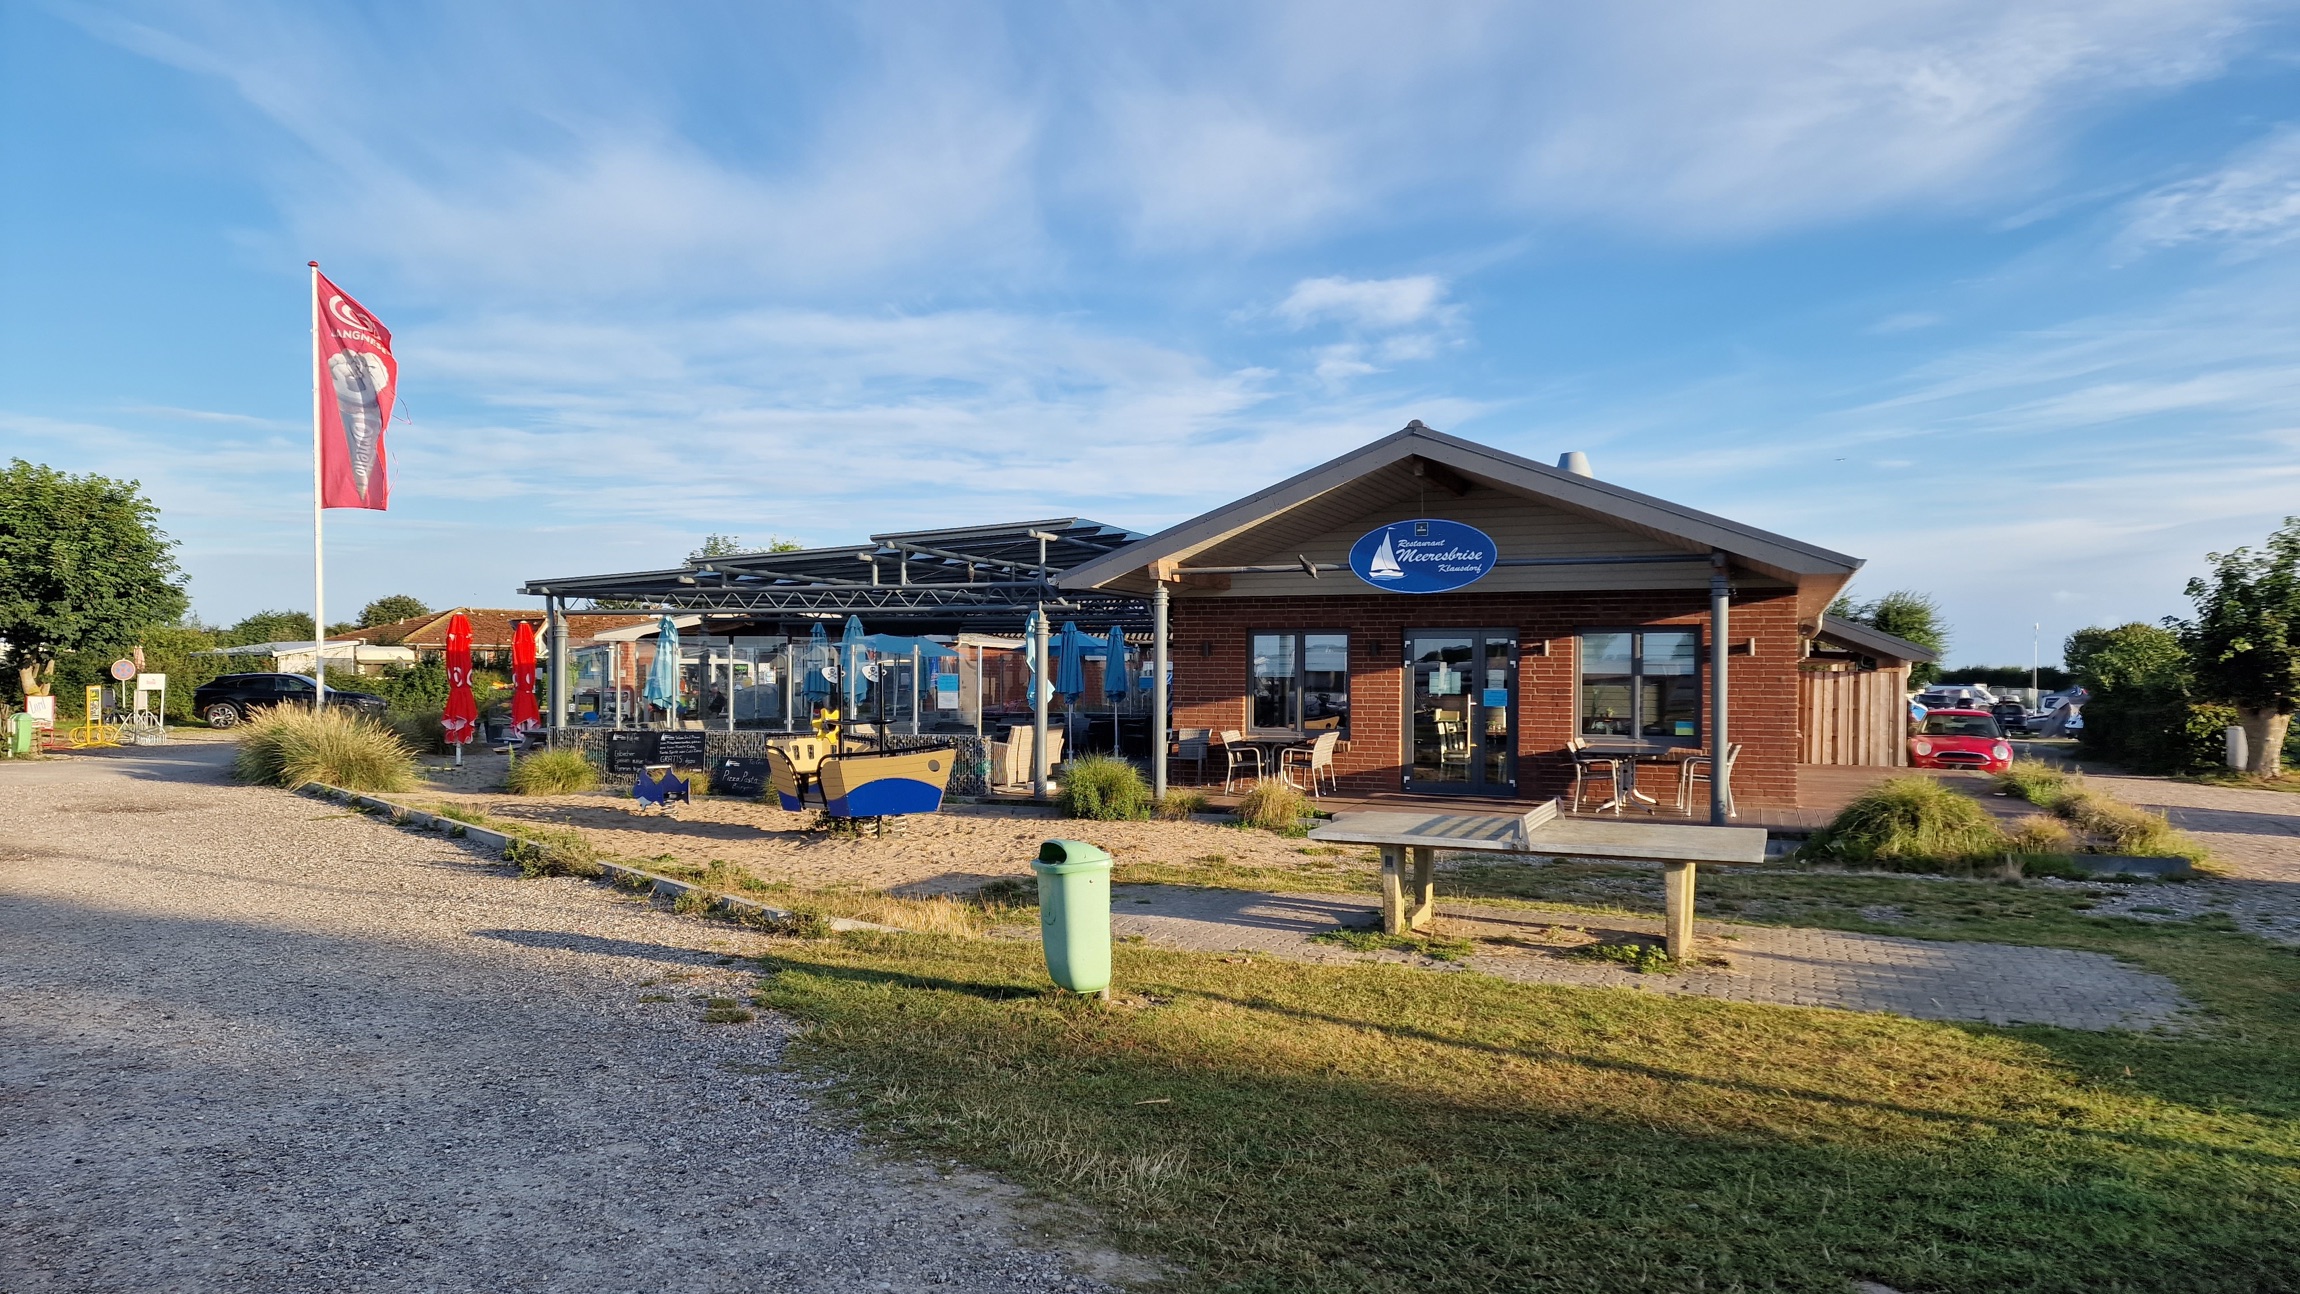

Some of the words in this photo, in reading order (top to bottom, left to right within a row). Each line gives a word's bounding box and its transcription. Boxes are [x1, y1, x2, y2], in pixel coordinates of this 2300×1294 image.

[1397, 539, 1446, 548] Restaurant
[1395, 547, 1483, 563] Meeresbrise
[1438, 563, 1482, 574] Klausdorf
[660, 755, 683, 763] GRATIS
[722, 769, 741, 782] Pizza
[740, 771, 760, 784] Pasta
